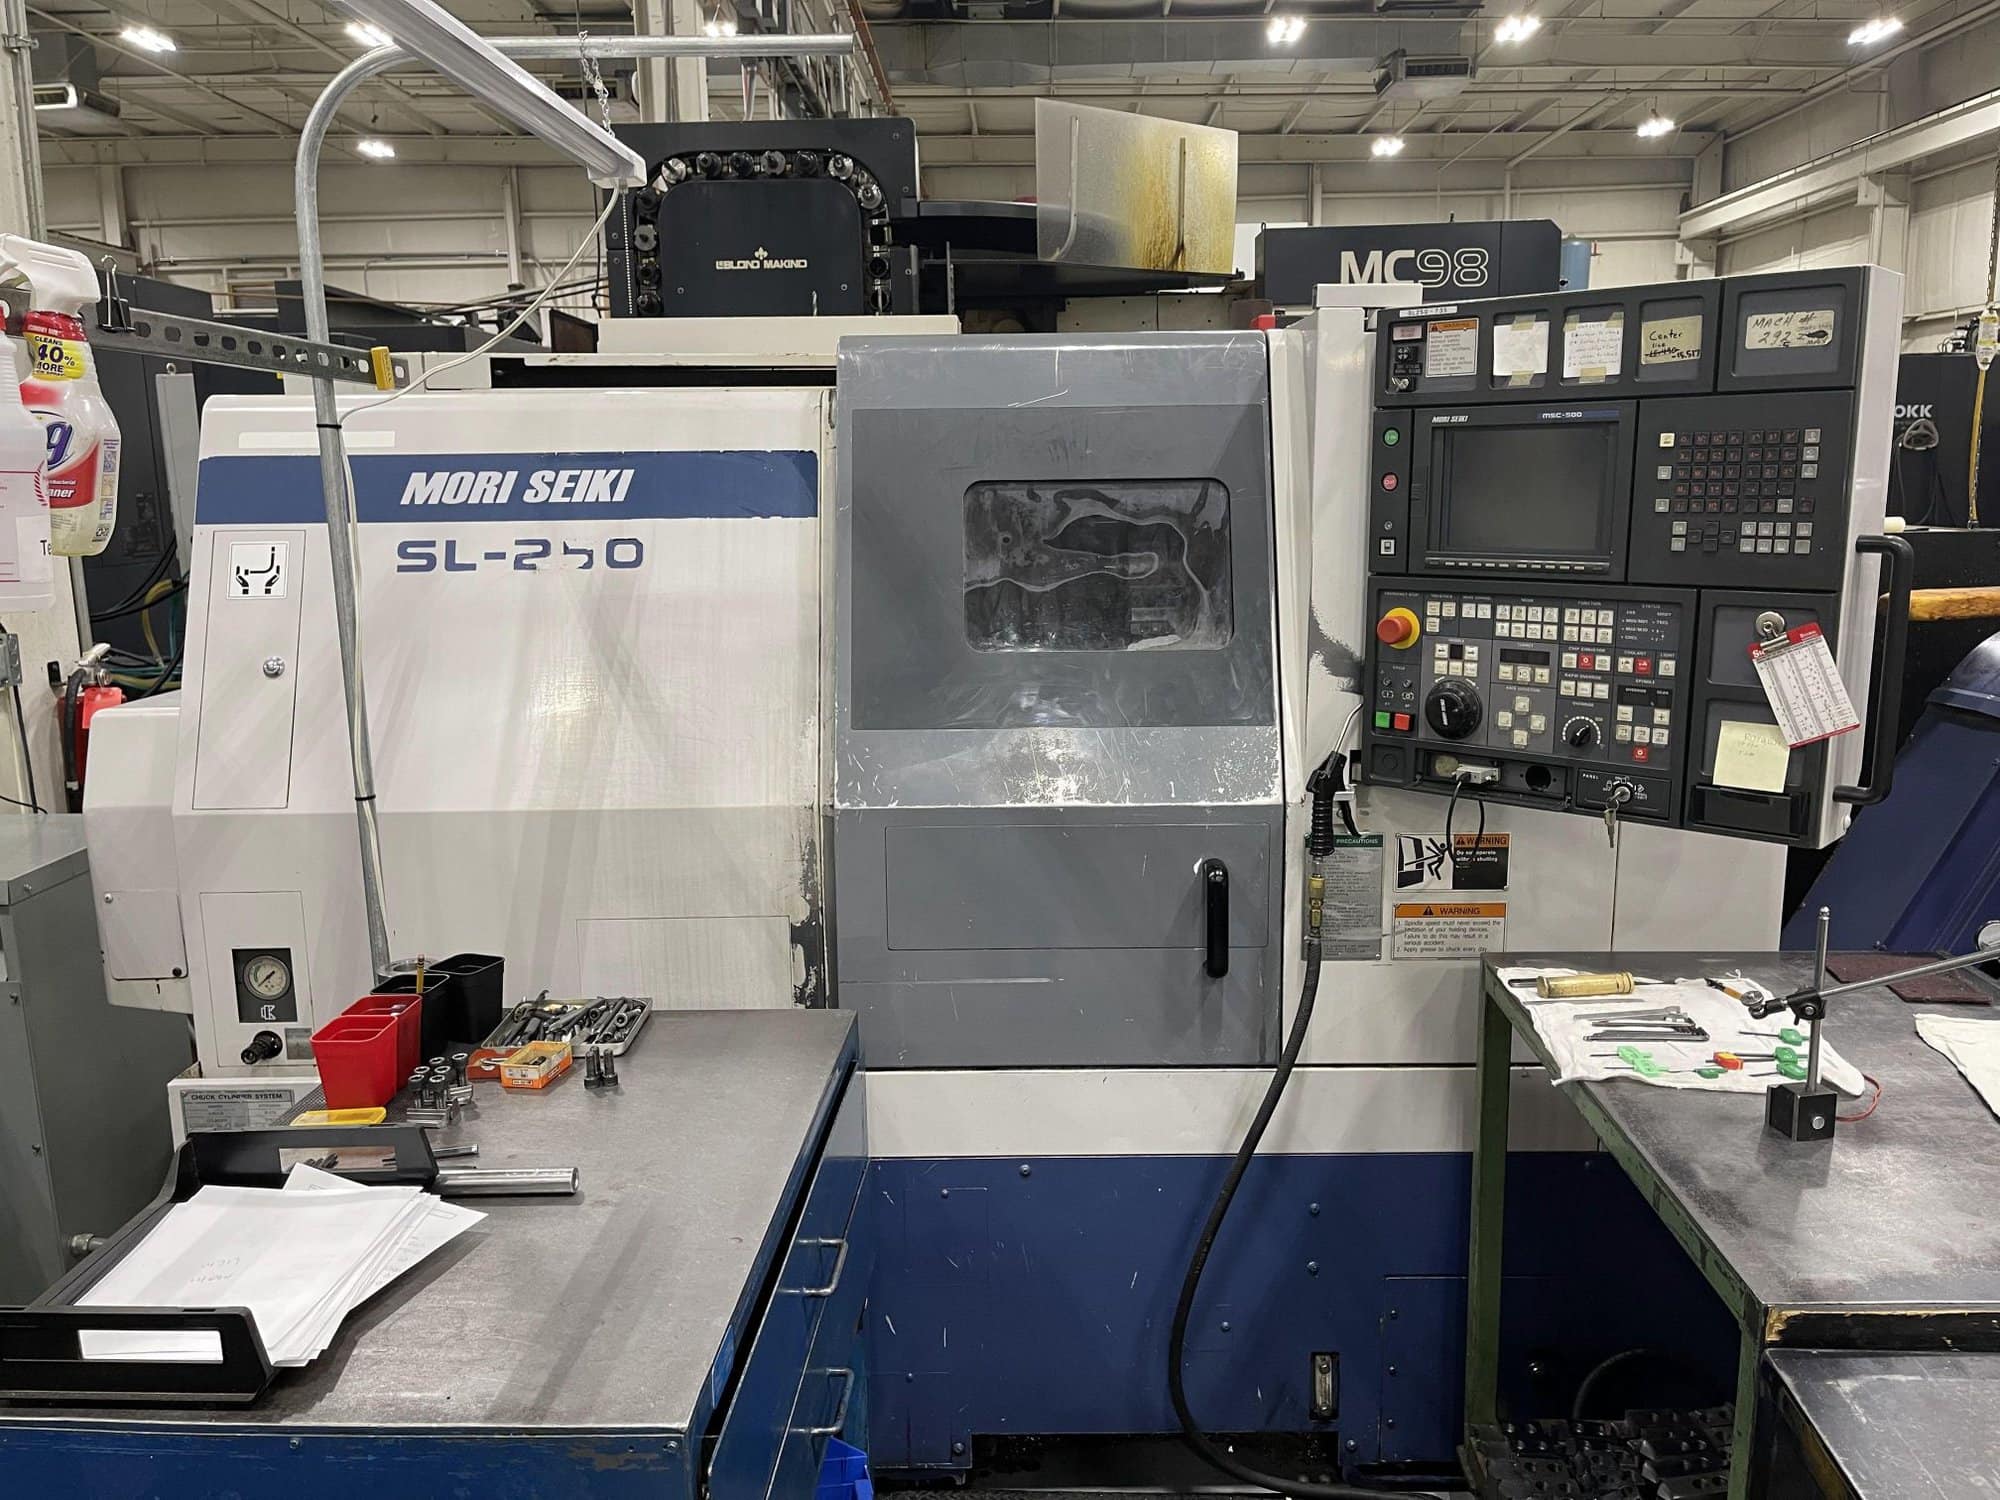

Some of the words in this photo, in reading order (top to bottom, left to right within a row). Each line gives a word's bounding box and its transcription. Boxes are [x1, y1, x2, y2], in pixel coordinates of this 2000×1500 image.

[763, 259, 808, 269] MAKINO
[1339, 247, 1490, 288] MC98
[1752, 314, 1794, 329] MACH
[34, 335, 64, 346] CLEANS
[1649, 328, 1684, 341] Center
[1894, 404, 1934, 418] OKK
[400, 470, 520, 505] MORI
[522, 468, 635, 504] SEIKI
[1440, 907, 1480, 915] WARNING
